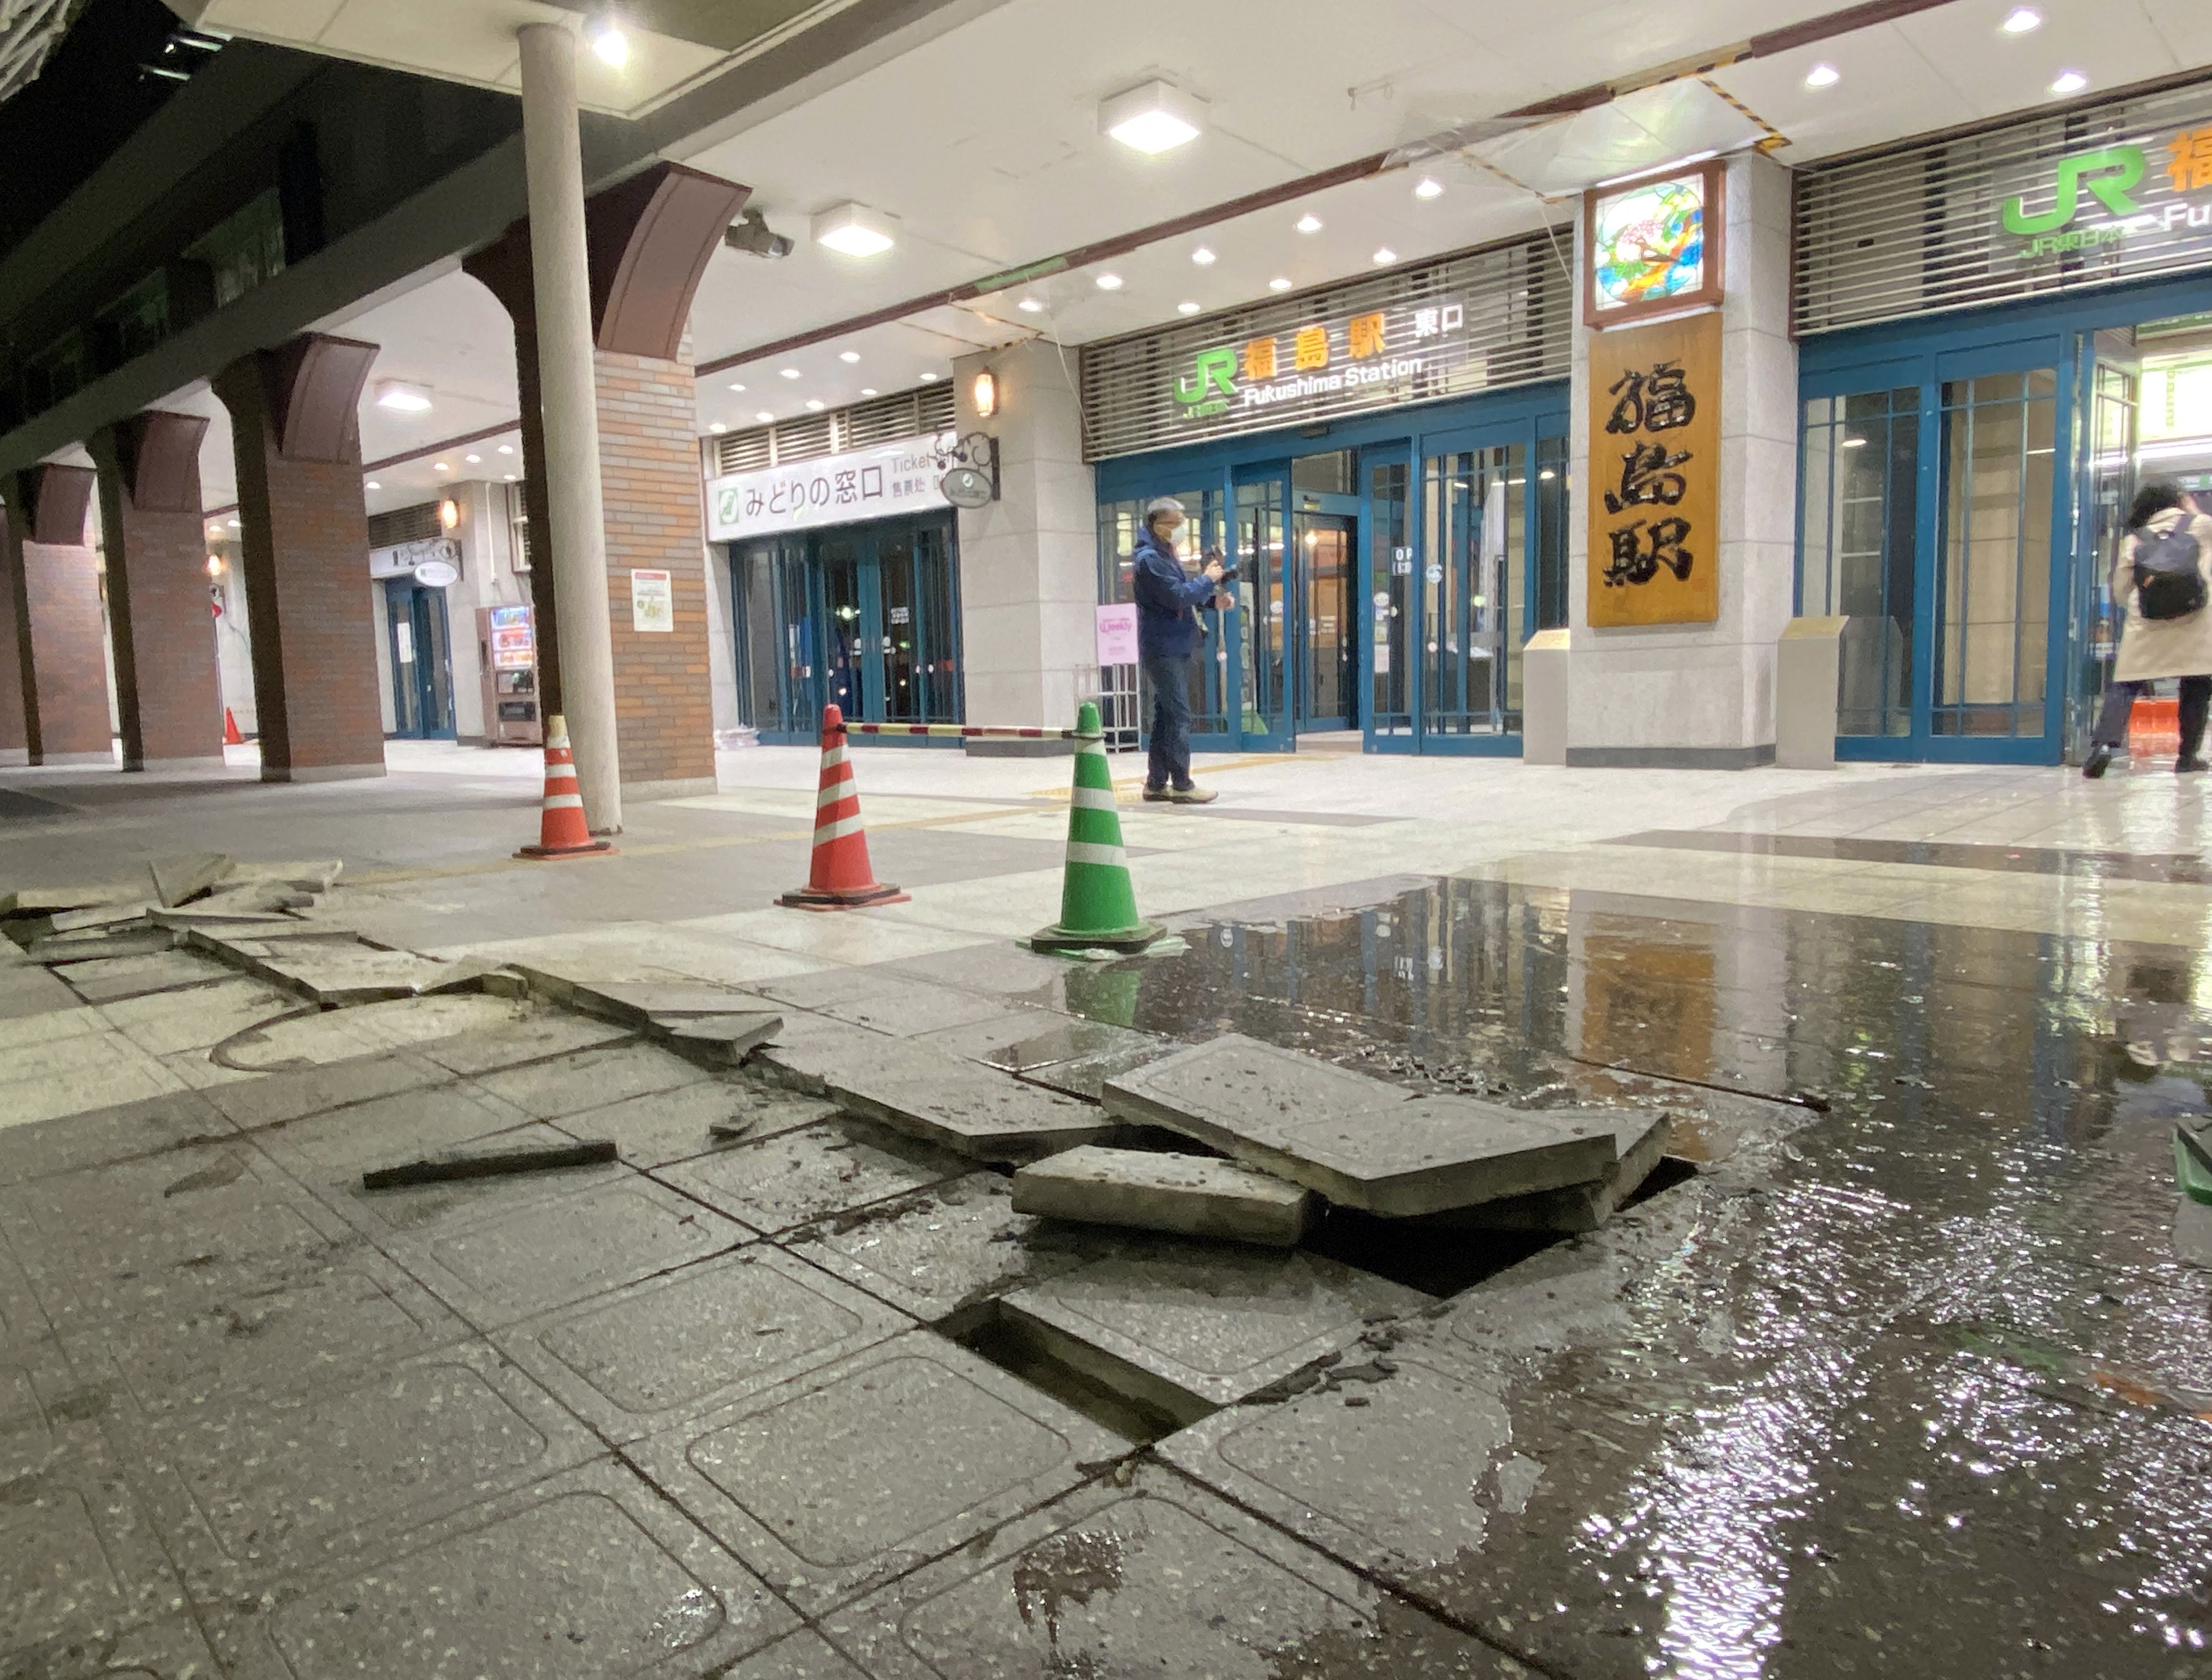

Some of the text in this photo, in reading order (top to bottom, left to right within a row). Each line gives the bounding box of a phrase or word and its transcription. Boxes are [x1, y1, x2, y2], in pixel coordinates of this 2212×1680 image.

[2003, 145, 2145, 234] JR
[1415, 304, 1463, 338] 東口
[1174, 347, 1238, 403] JR
[1244, 358, 1422, 407] Fukushima Station
[892, 452, 930, 474] Ticket
[746, 465, 882, 517] みどりの窓口
